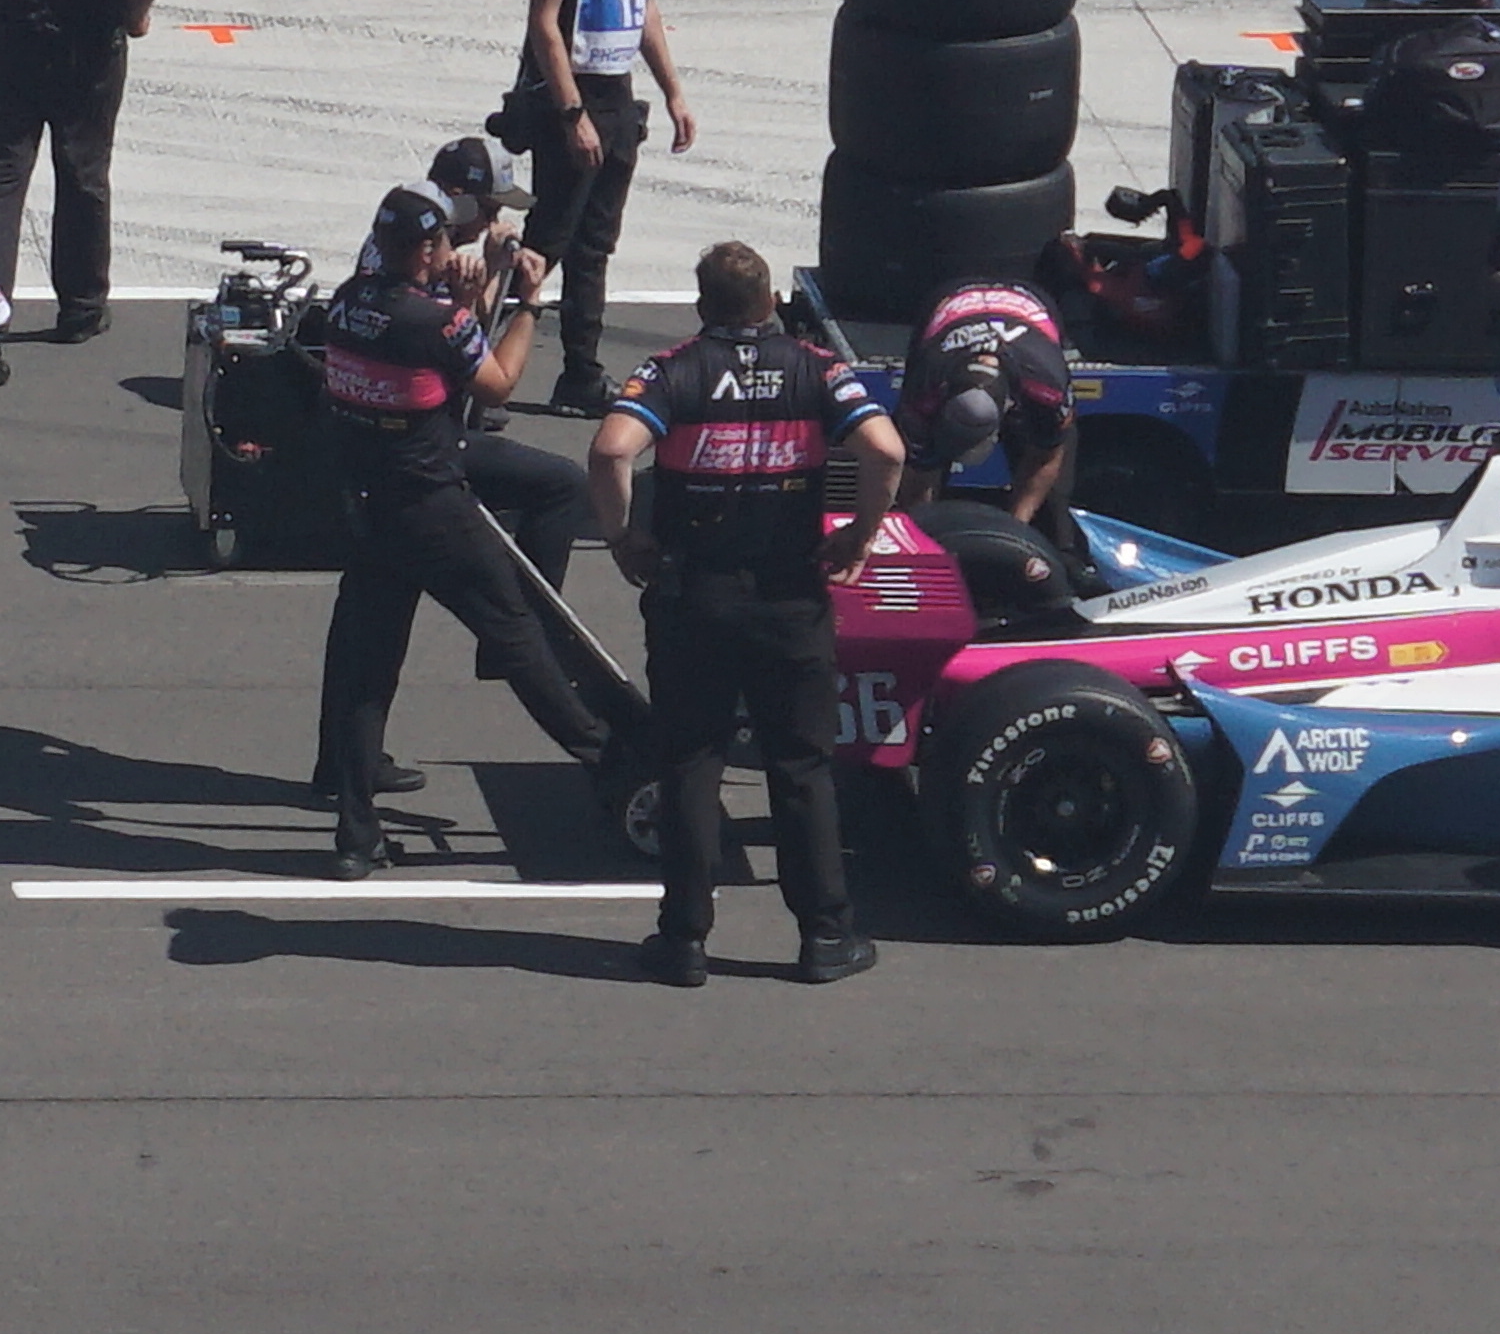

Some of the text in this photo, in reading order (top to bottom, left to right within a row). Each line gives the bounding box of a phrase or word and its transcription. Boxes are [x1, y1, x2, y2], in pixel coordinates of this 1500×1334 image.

[1246, 571, 1443, 616] HONDA
[1229, 634, 1379, 672] CLIFFS
[967, 702, 1079, 786] Firestone
[1296, 727, 1371, 750] ARCTIC
[1305, 751, 1364, 771] WOLF
[1252, 811, 1325, 828] CLIFFS
[1067, 843, 1176, 924] Firestone
